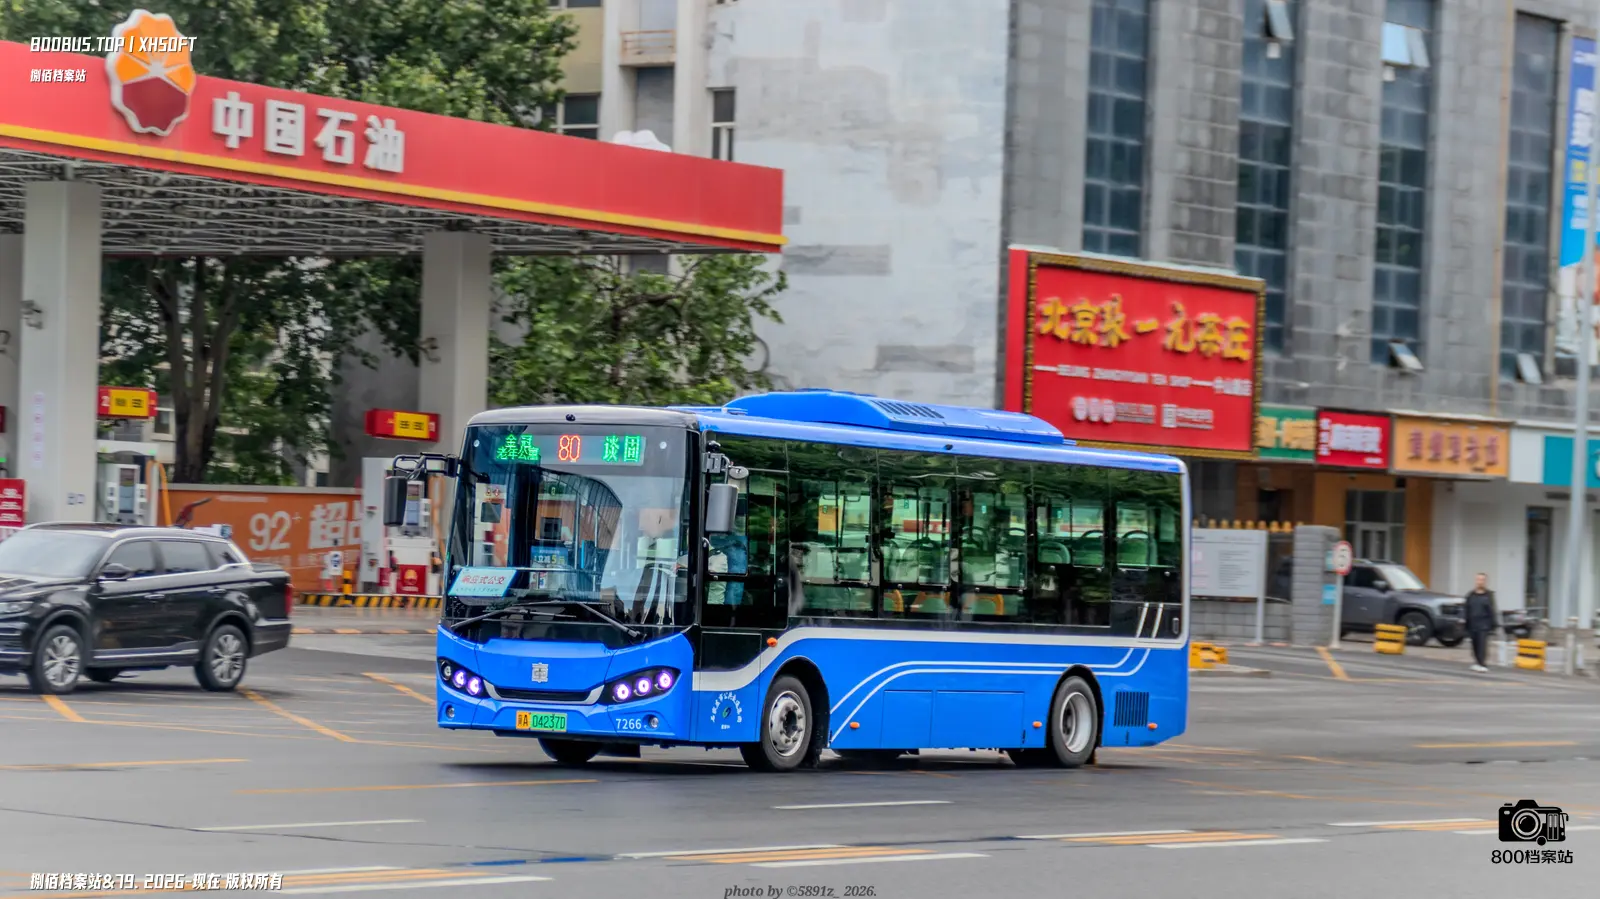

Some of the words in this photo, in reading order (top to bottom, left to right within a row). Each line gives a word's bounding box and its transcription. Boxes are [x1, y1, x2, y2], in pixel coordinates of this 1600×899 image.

[212, 91, 405, 173] 中国石油
[558, 434, 581, 462] 80
[616, 718, 642, 730] 7266
